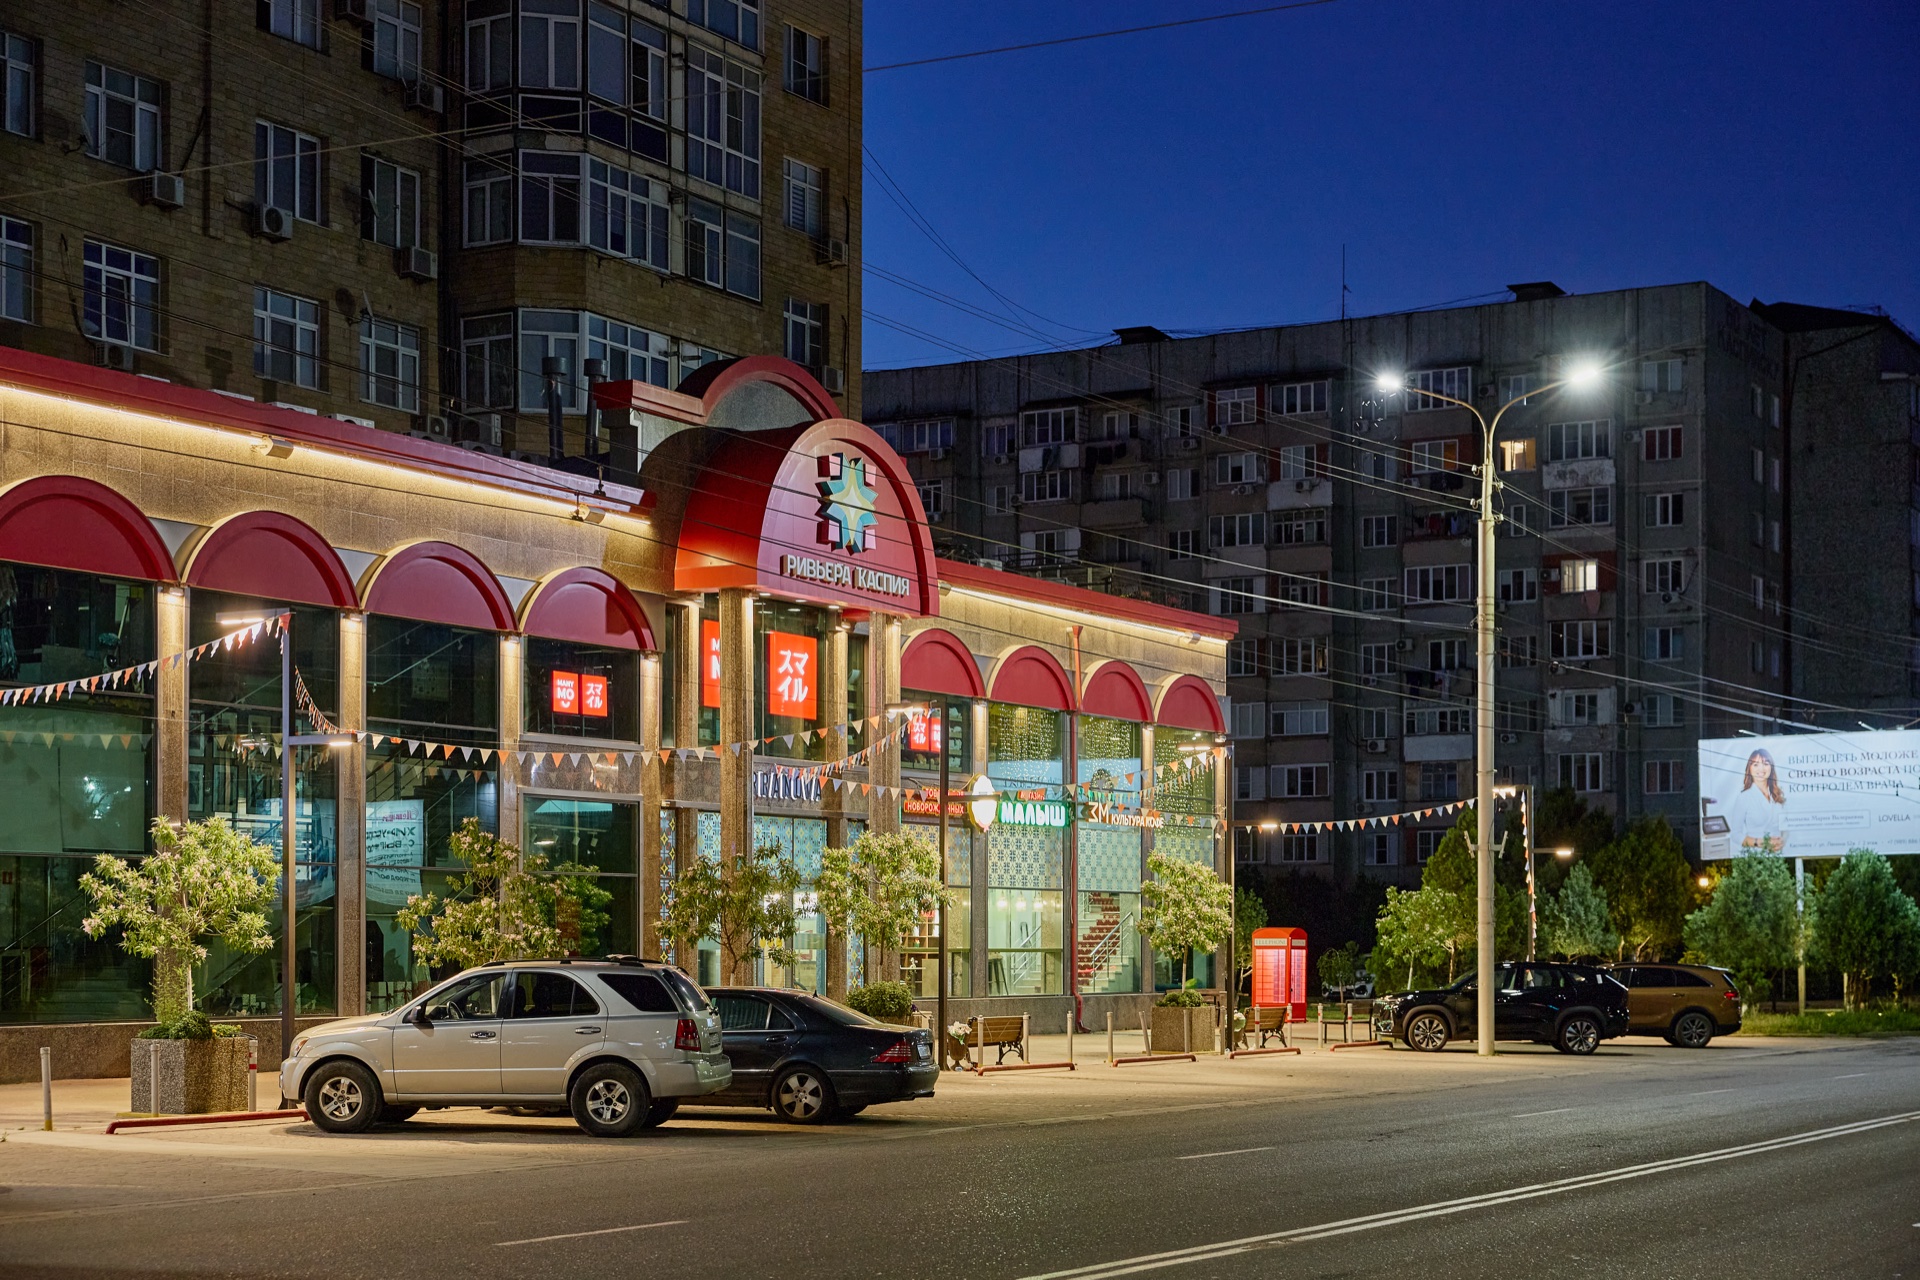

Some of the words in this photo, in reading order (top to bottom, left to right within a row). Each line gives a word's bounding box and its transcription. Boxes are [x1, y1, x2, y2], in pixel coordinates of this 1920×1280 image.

[786, 554, 852, 586] РИВЬЕРА
[856, 566, 910, 597] КАСПИЯ
[779, 649, 808, 675] スマ
[557, 679, 574, 687] MANY
[586, 683, 603, 695] スマ
[778, 676, 808, 702] イル
[557, 687, 575, 700] MO
[586, 695, 603, 709] イル
[1788, 752, 1858, 765] ВЫГЛЯДЕТЬ
[1860, 750, 1918, 761] МОЛОЖЕ
[1788, 767, 1837, 779] СВОЕГО
[1840, 765, 1900, 777] ВОЗРАСТА
[1789, 781, 1864, 793] КОНТРОЛЕМ
[1866, 780, 1904, 790] ВРАЧА
[1001, 801, 1066, 827] МАЛЫШ
[1111, 813, 1145, 827] КУЛЬТУРА
[1145, 815, 1164, 828] КОФЕ
[1878, 814, 1911, 822] LOVELLA
